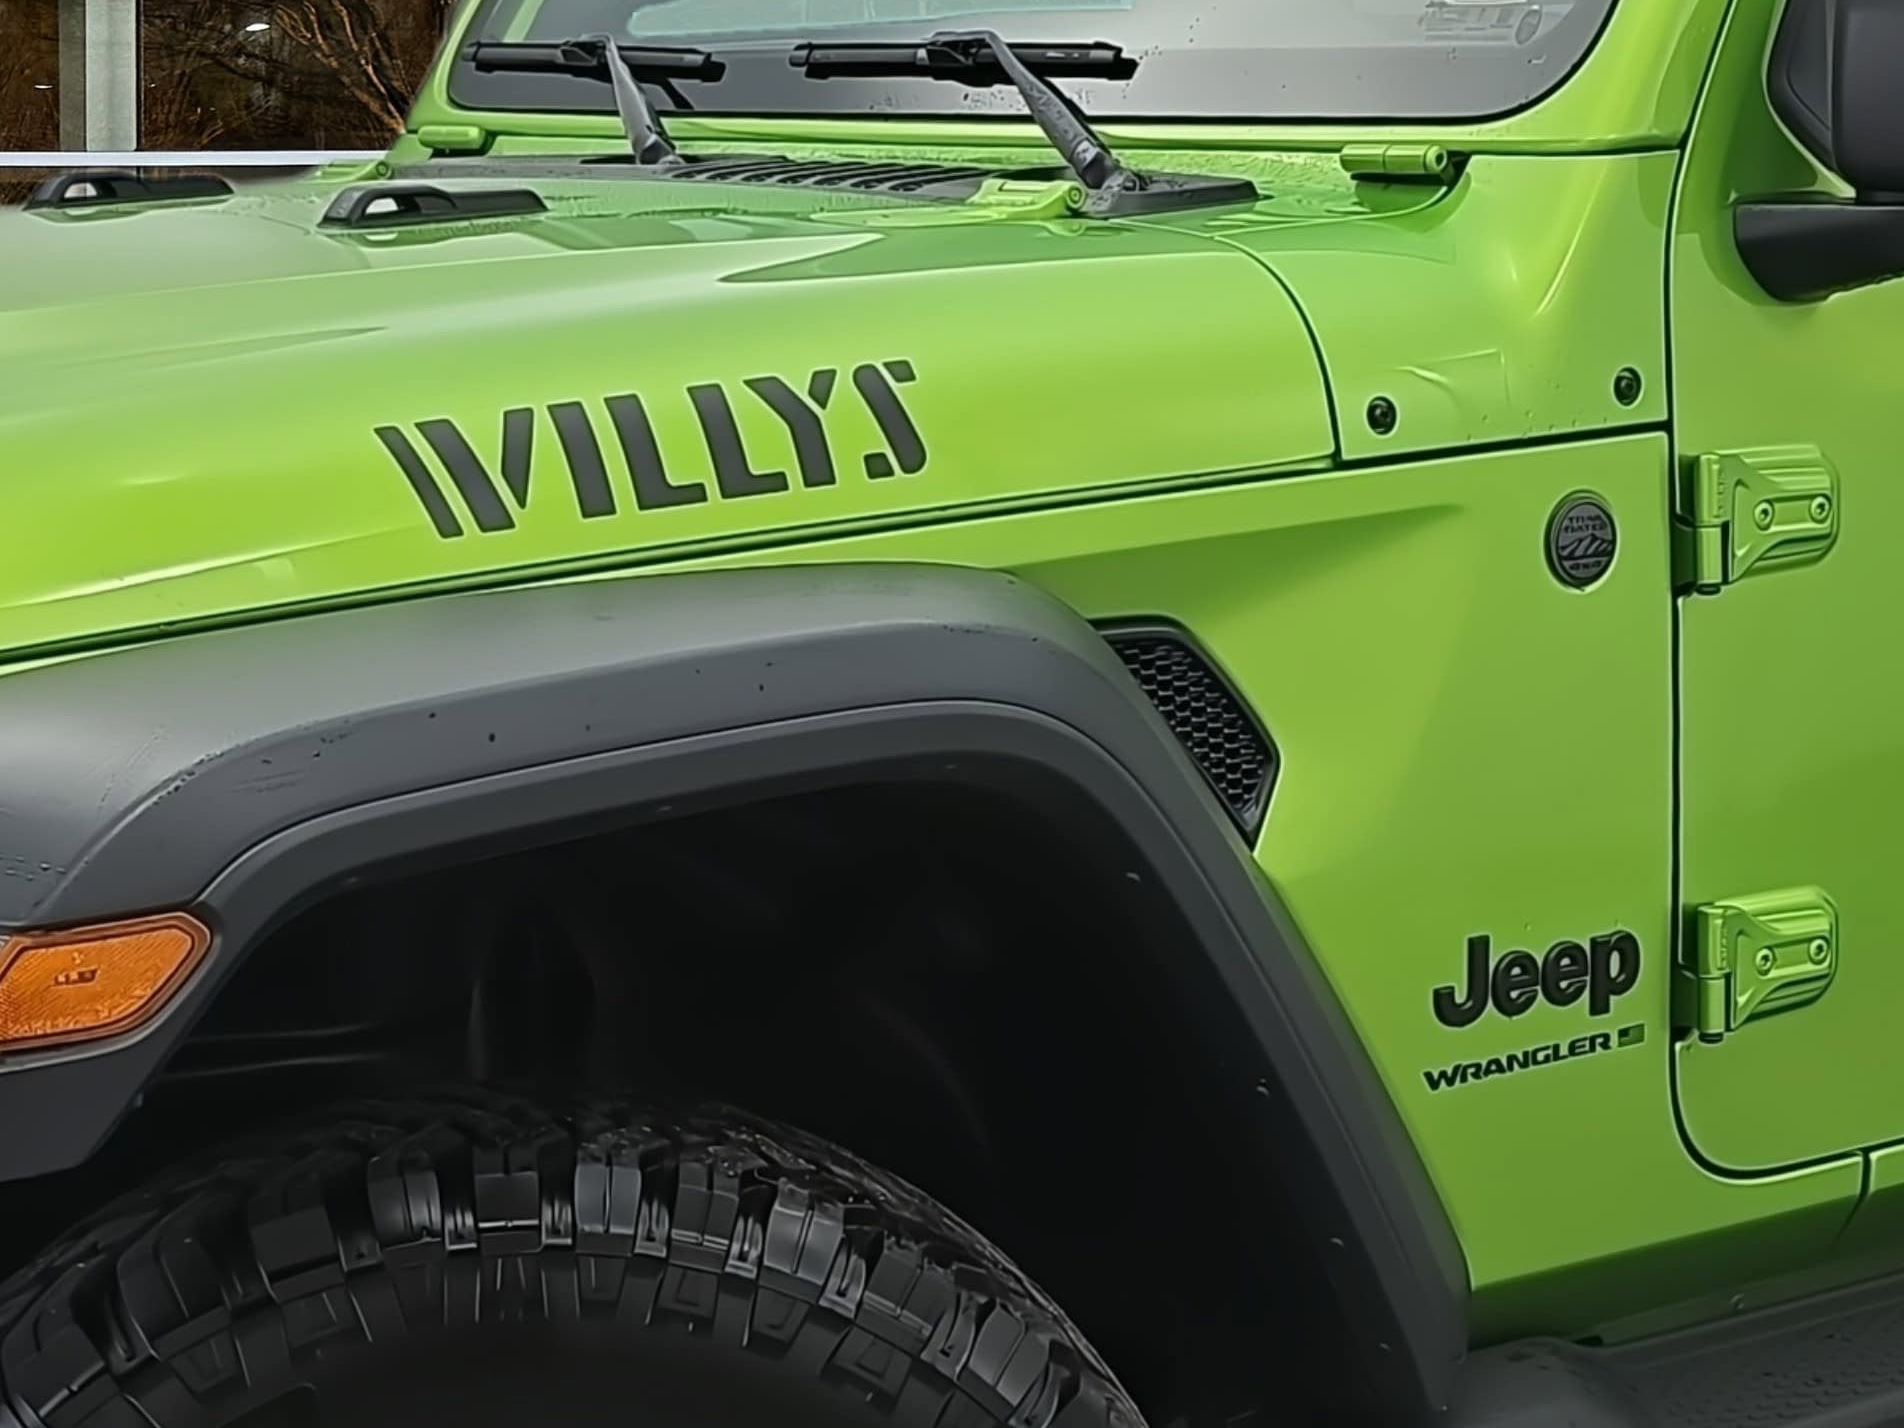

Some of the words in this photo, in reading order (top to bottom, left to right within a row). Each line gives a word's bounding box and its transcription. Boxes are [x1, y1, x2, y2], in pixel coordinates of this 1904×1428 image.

[373, 358, 928, 540] WILLYS
[1432, 929, 1641, 1028] Jeep
[1422, 1032, 1612, 1091] WRANGLER
